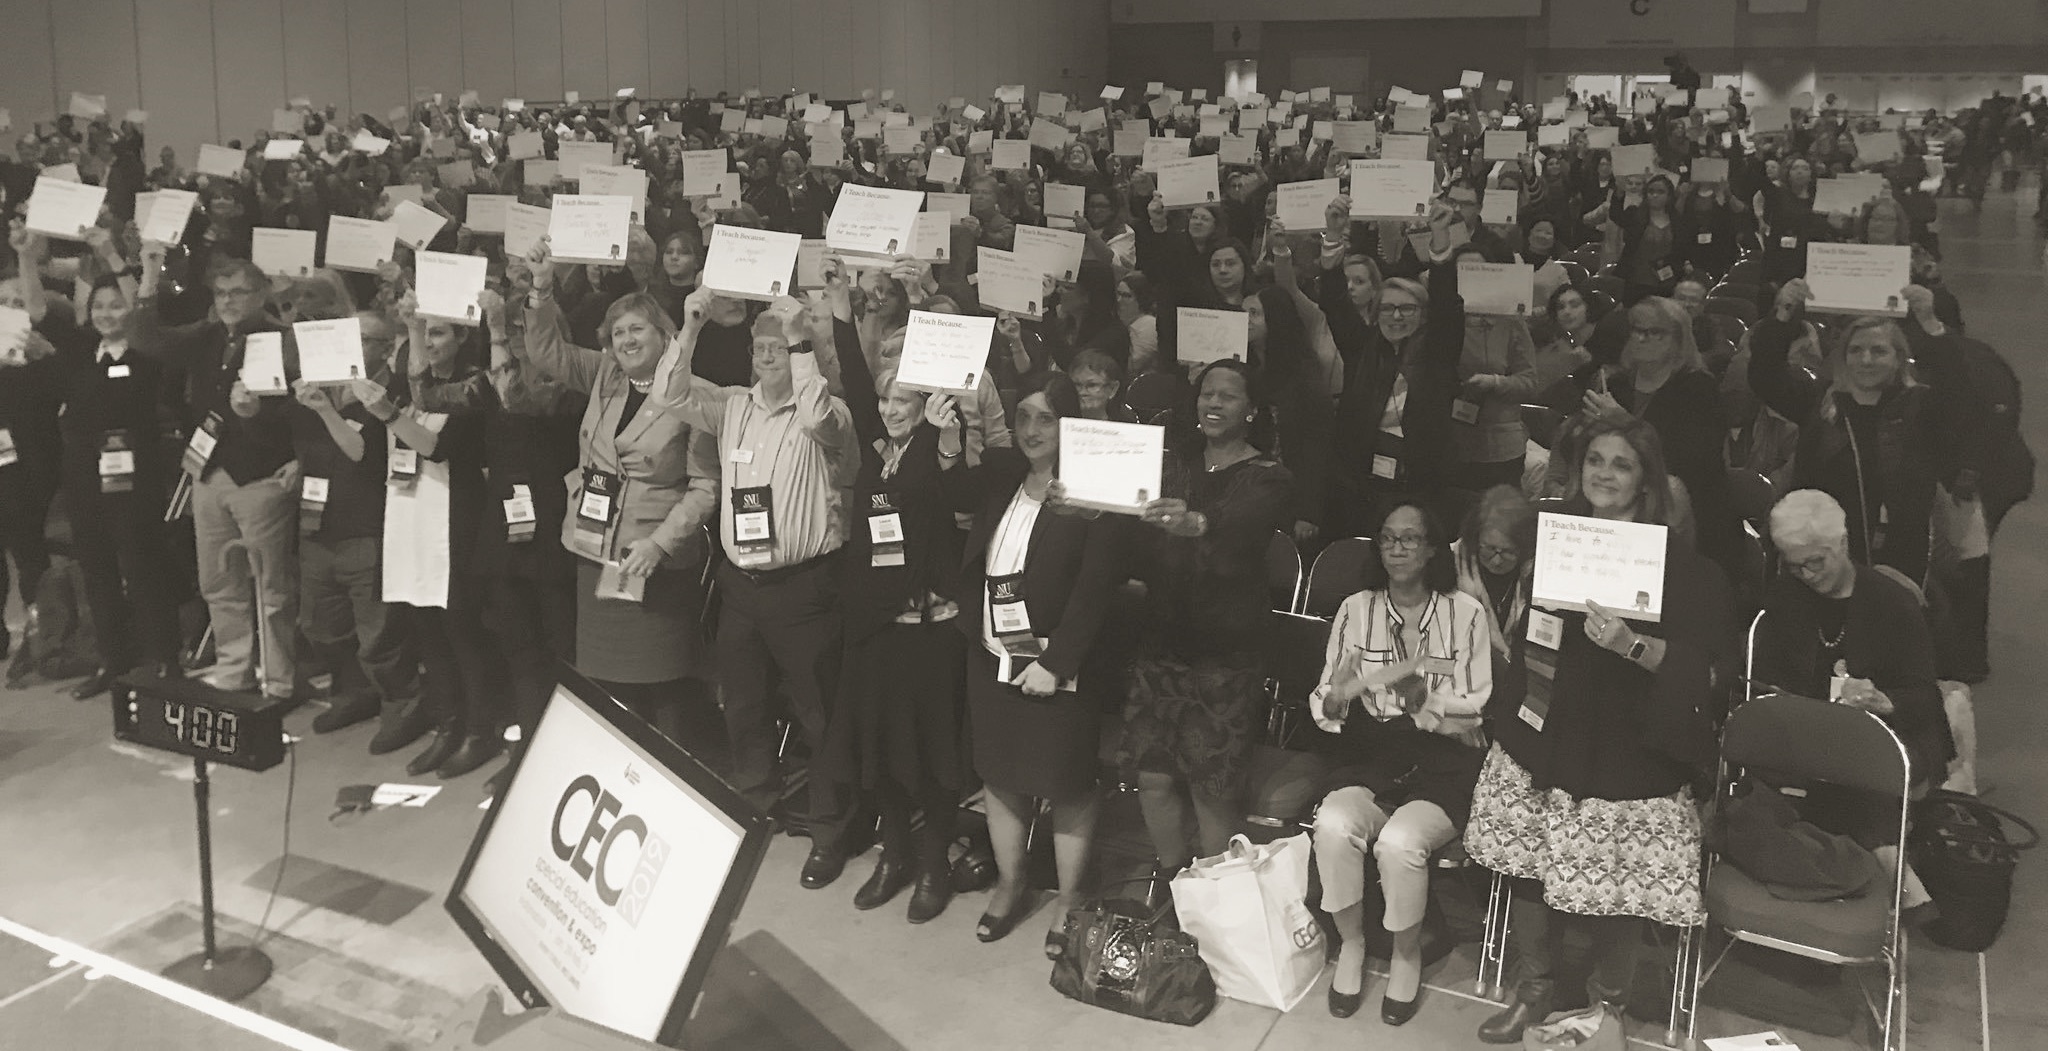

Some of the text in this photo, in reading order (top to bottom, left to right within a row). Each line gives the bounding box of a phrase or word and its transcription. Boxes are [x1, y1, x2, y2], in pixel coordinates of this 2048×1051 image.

[1630, 0, 1650, 16] C
[721, 229, 739, 239] Teach
[918, 316, 936, 326] Teach
[1550, 520, 1577, 531] Teach
[550, 774, 648, 907] CEC
[622, 838, 665, 924] 2019
[526, 877, 570, 926] convention
[566, 918, 576, 934] &
[574, 928, 598, 956] expo
[564, 885, 608, 936] education
